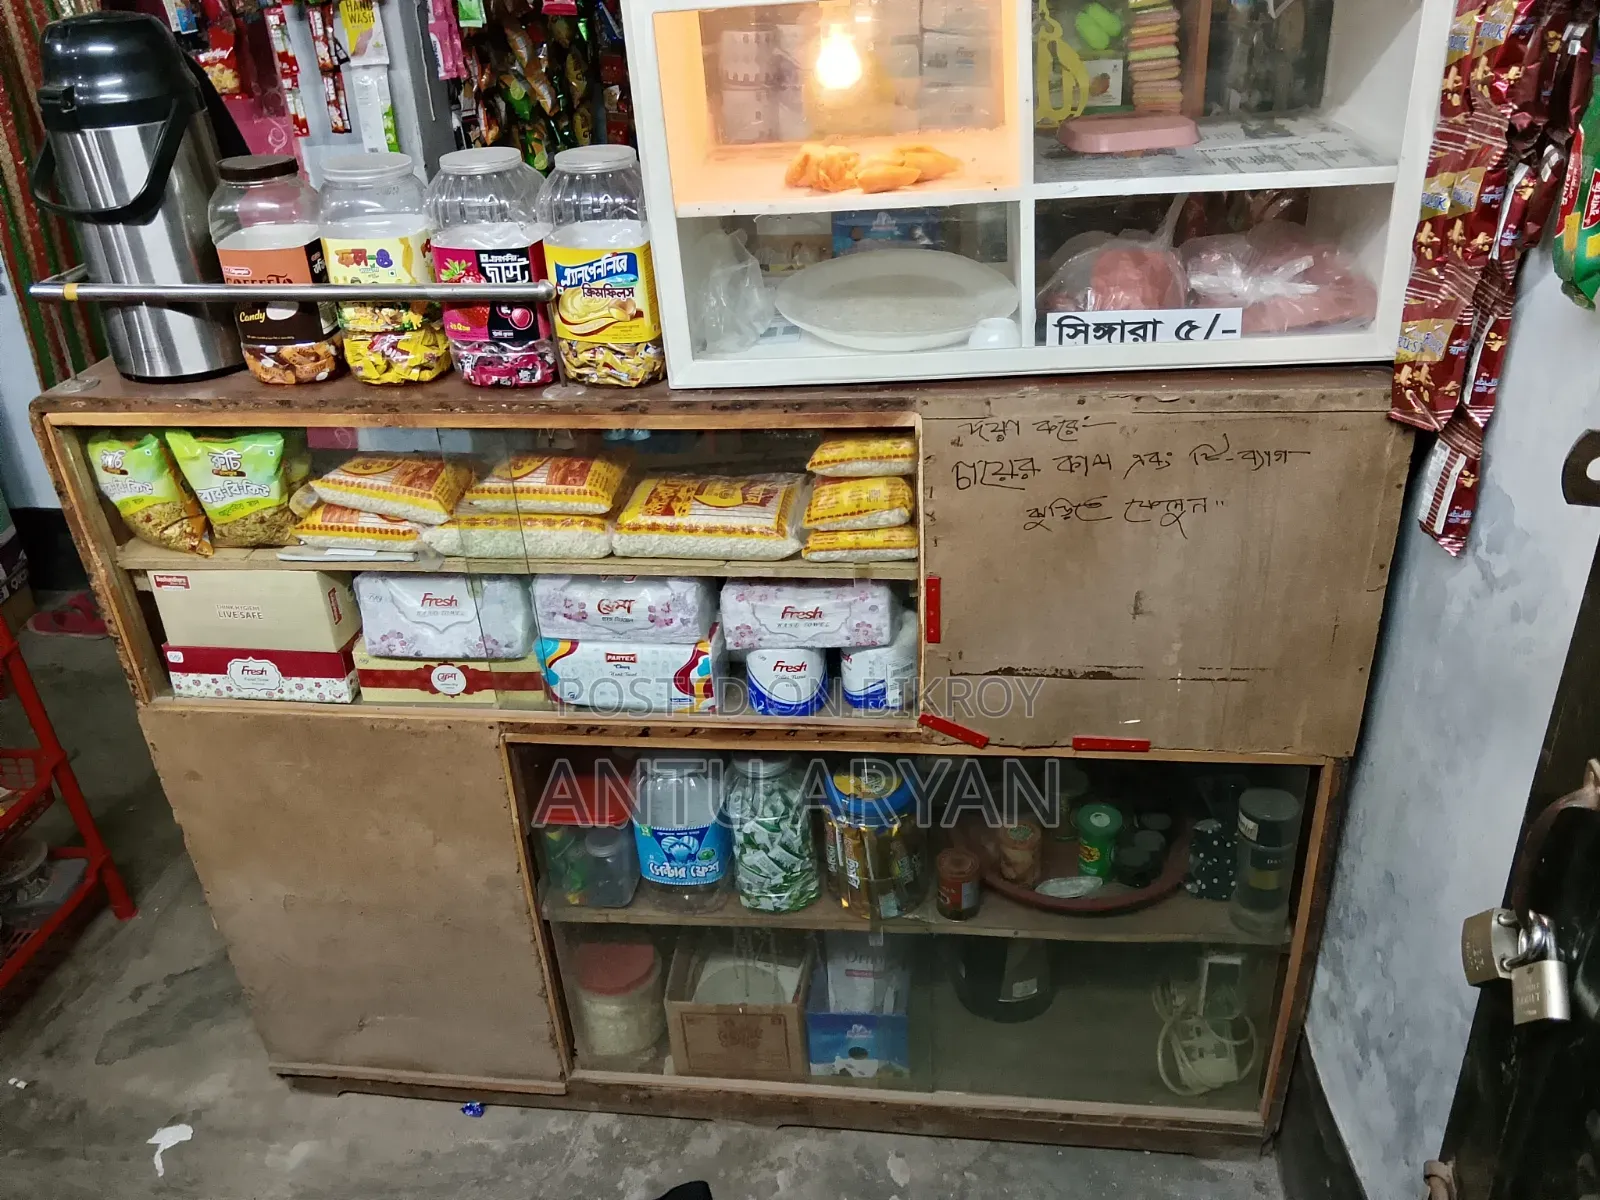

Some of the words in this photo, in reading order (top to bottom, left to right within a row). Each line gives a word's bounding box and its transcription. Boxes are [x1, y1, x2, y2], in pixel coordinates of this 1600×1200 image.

[348, 11, 375, 24] WASH
[240, 309, 265, 323] Candy
[1052, 314, 1164, 345] সিঙ্গারা
[208, 448, 243, 470] রুচি
[421, 592, 458, 608] Fresh
[218, 611, 238, 619] LIVE
[239, 611, 263, 620] SAFE
[781, 606, 823, 620] Fresh
[241, 665, 268, 676] Fresh
[773, 660, 808, 673] Fresh
